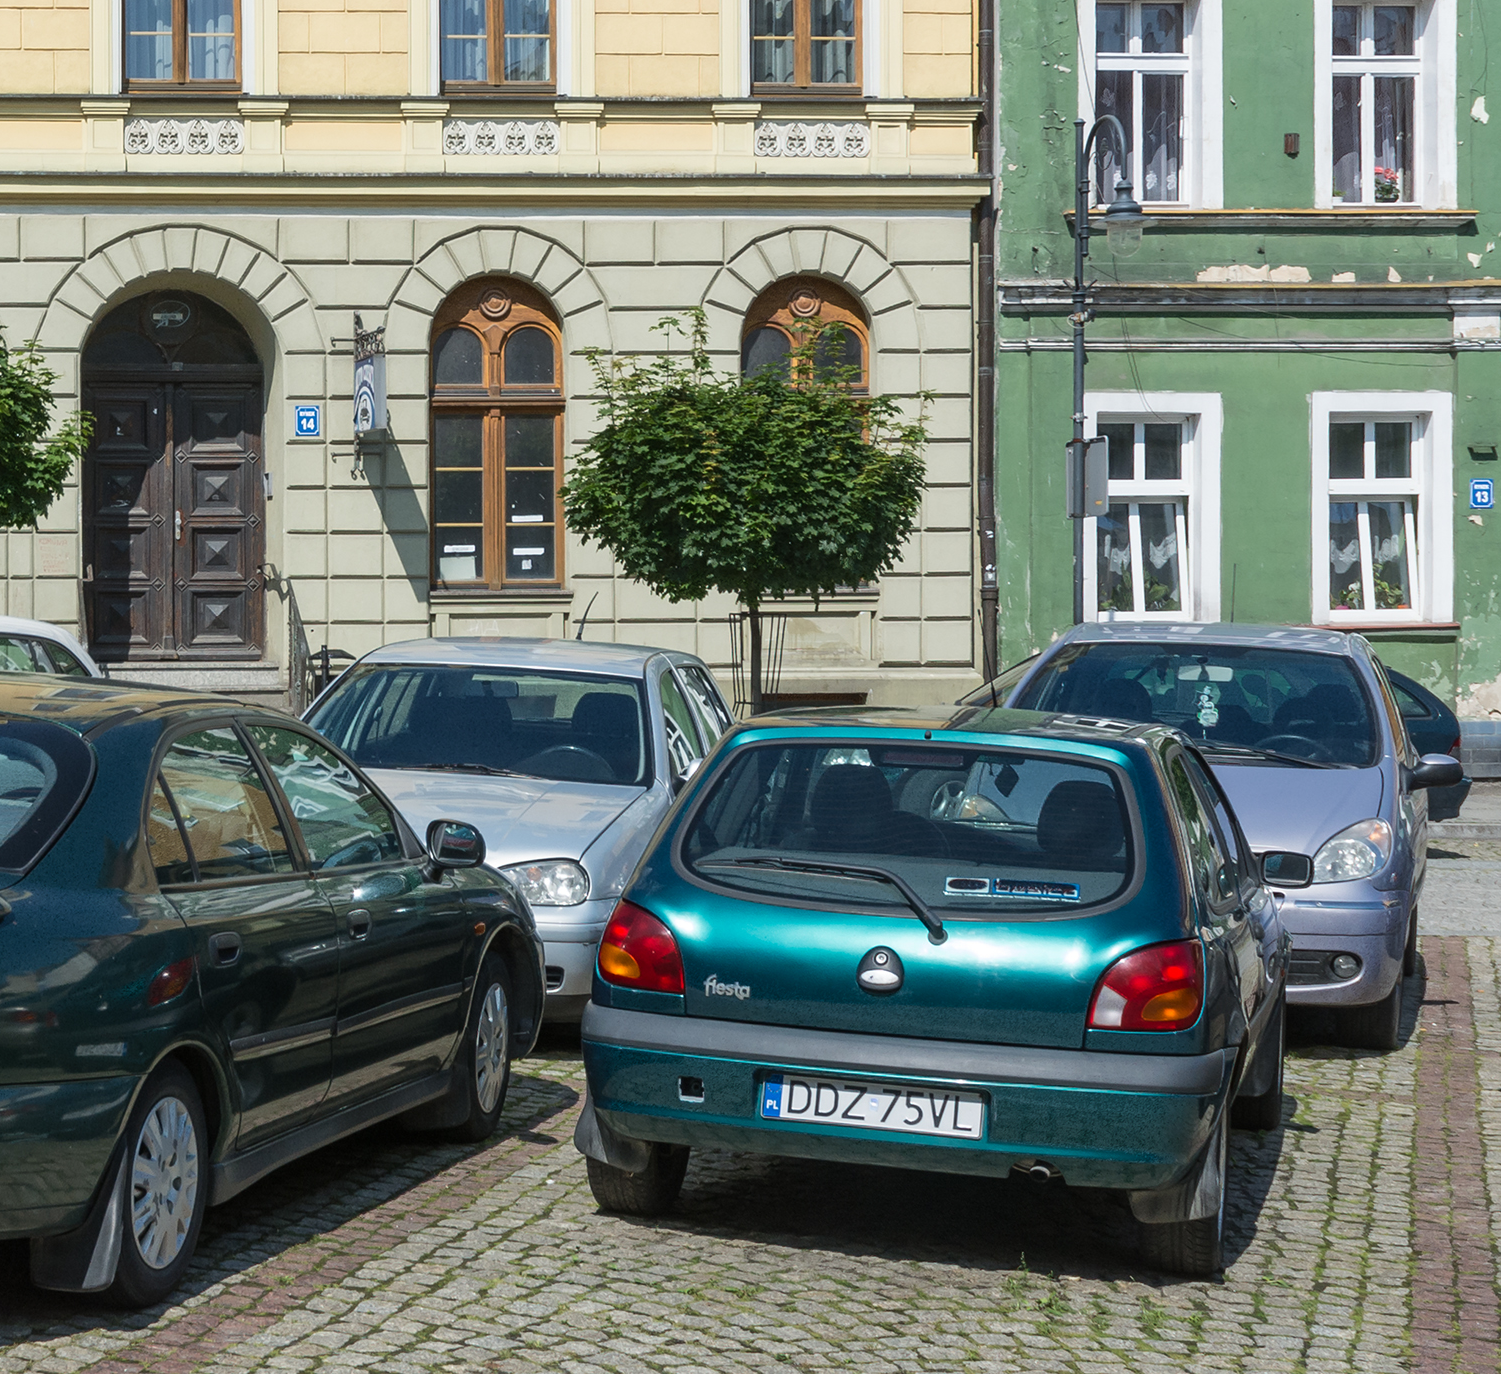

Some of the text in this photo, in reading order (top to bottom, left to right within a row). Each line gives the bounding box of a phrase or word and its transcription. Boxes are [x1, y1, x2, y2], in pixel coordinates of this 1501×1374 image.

[301, 418, 315, 430] 14
[1475, 491, 1489, 503] 13
[765, 1099, 779, 1111] PL
[787, 1079, 973, 1132] DDZ 75VL
